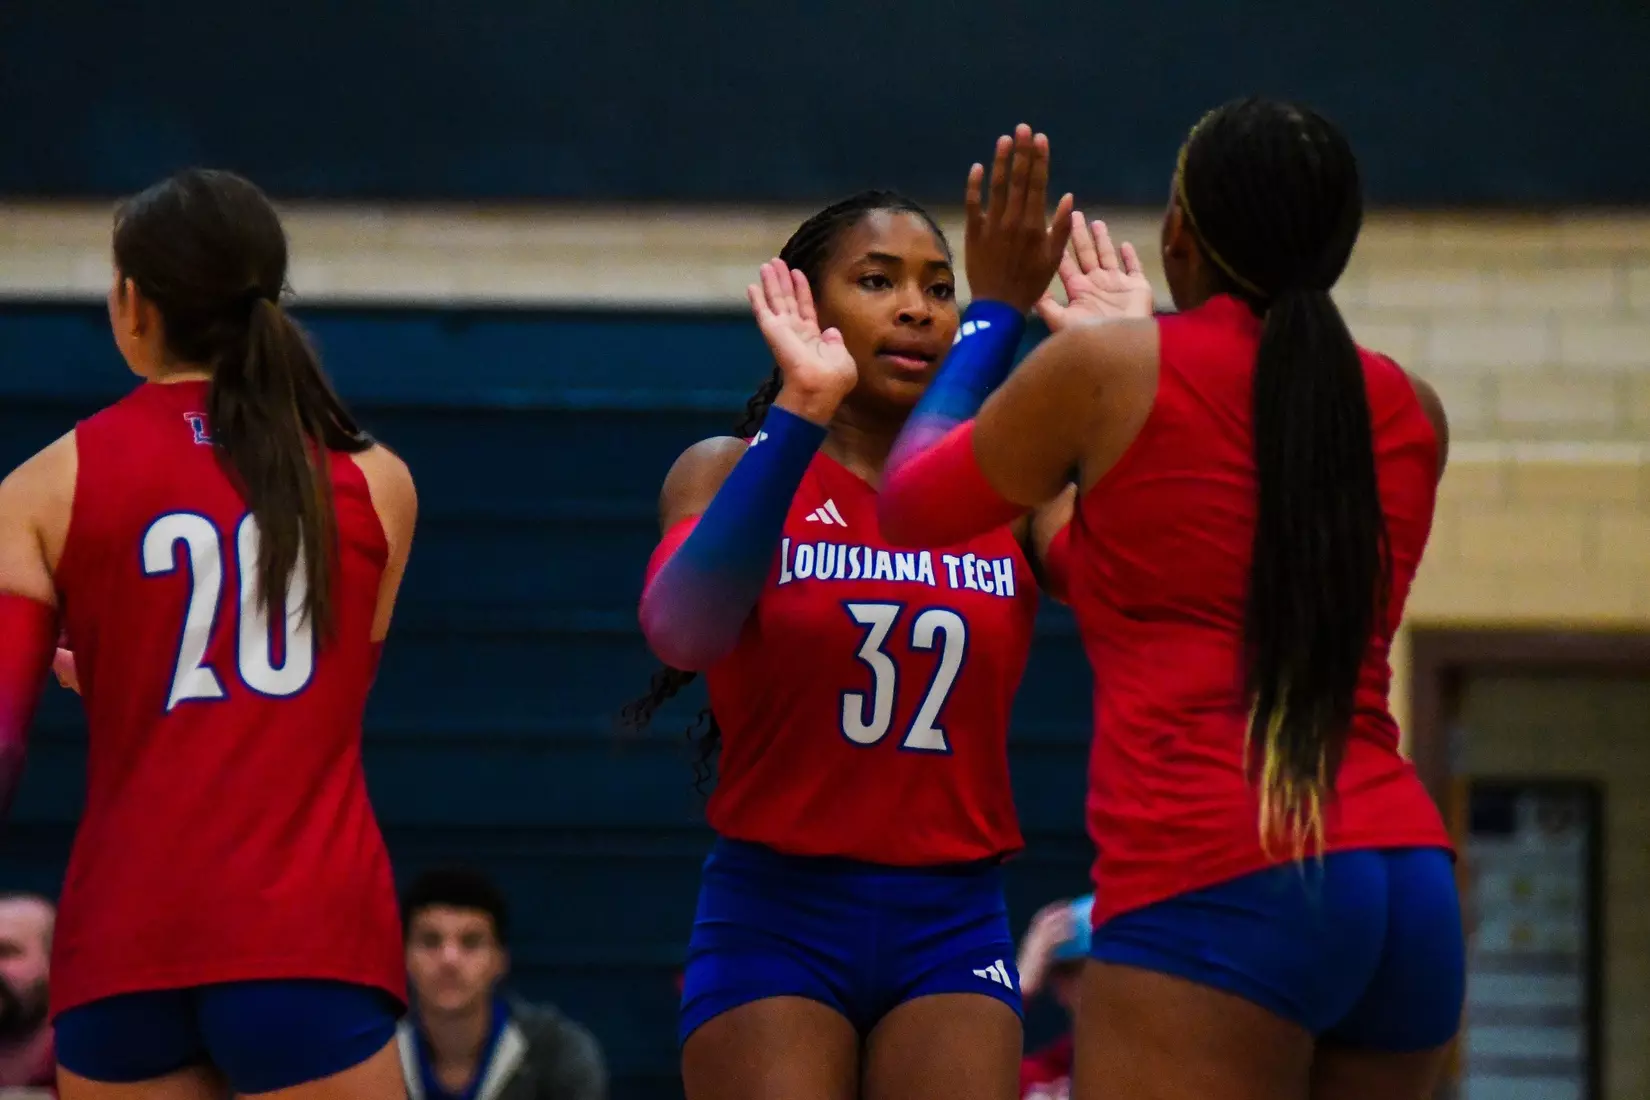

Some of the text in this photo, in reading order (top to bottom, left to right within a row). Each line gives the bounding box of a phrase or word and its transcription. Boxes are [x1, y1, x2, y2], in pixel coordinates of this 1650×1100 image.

[142, 511, 314, 712] 20
[778, 537, 1015, 597] LOUISIANA TECH
[841, 601, 967, 752] 32
